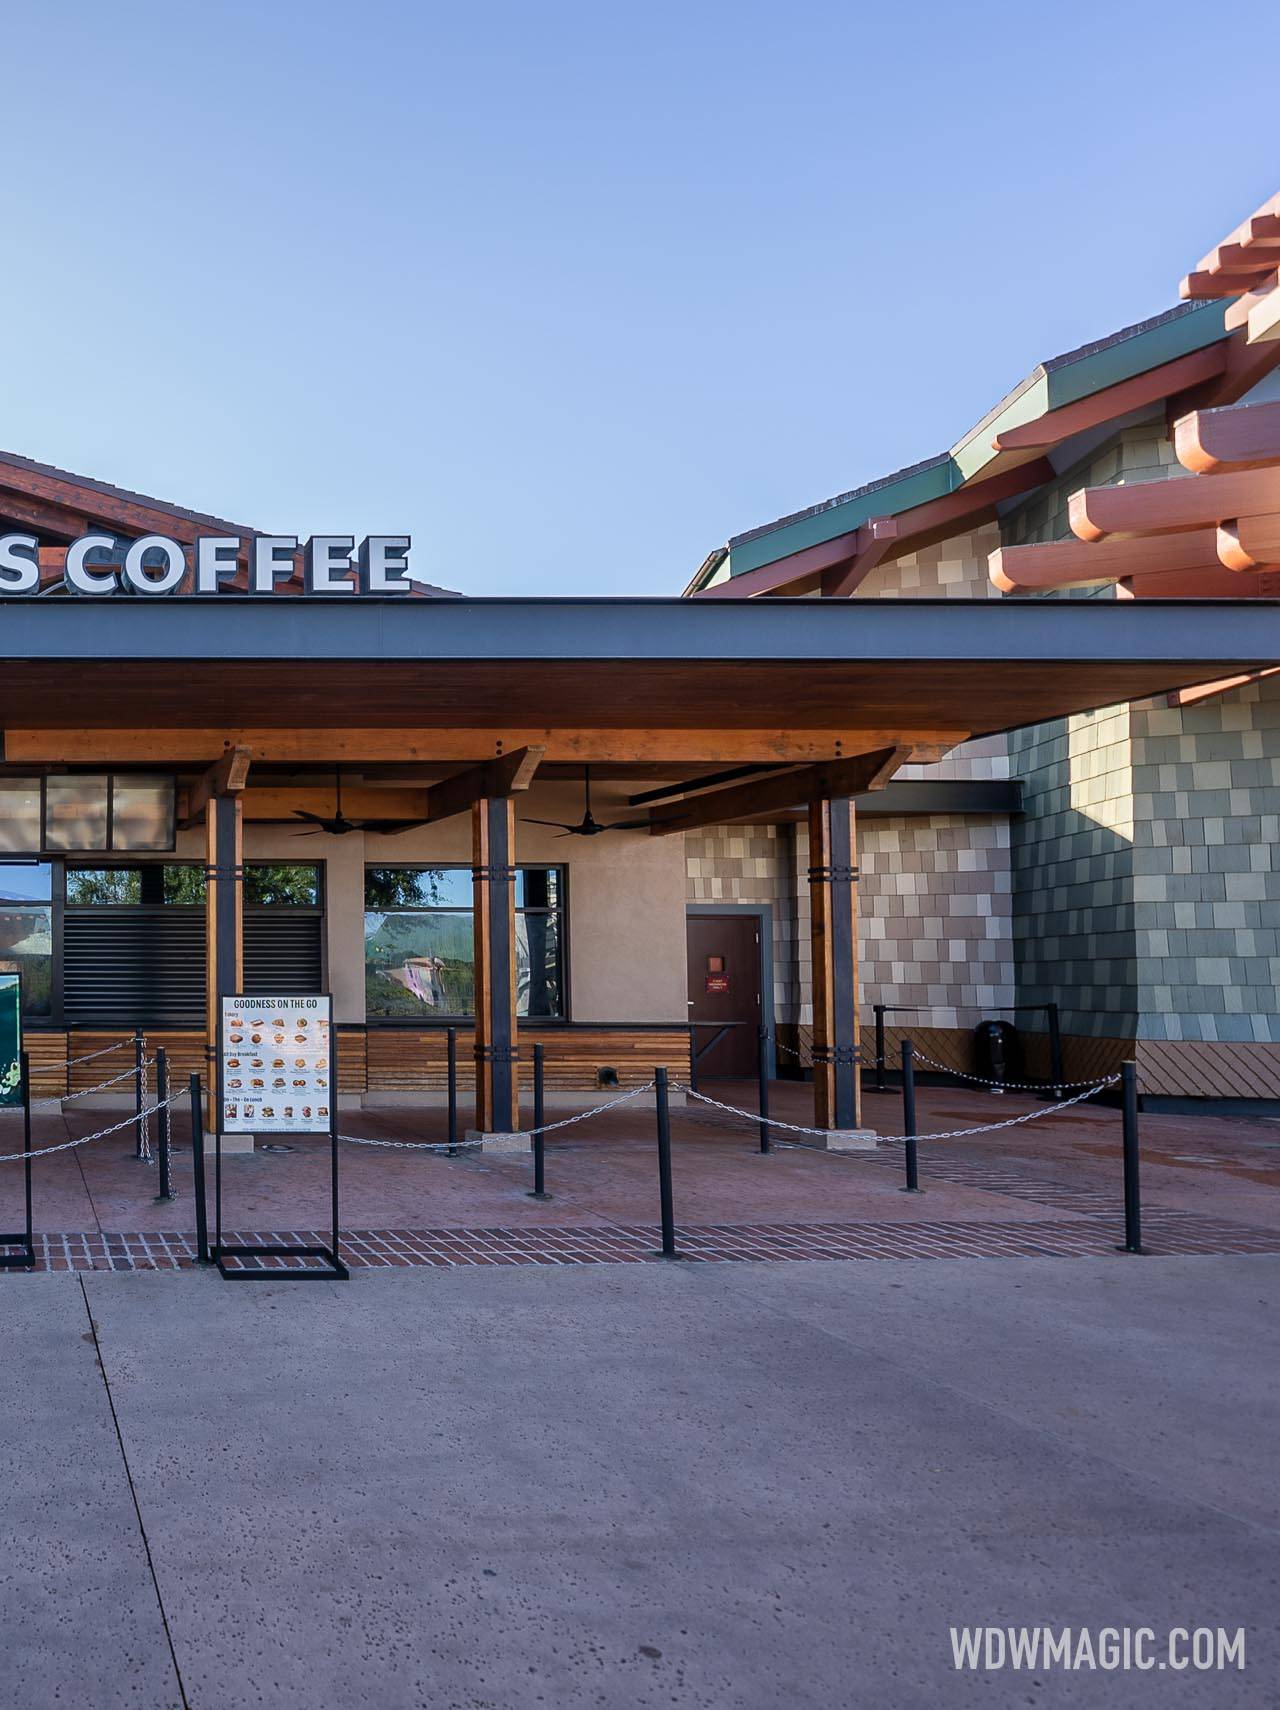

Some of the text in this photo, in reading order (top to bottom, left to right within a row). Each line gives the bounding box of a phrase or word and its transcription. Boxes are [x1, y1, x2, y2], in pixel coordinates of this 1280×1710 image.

[64, 534, 412, 592] COFFEE
[234, 1000, 318, 1008] GOODNESS ON THE GO
